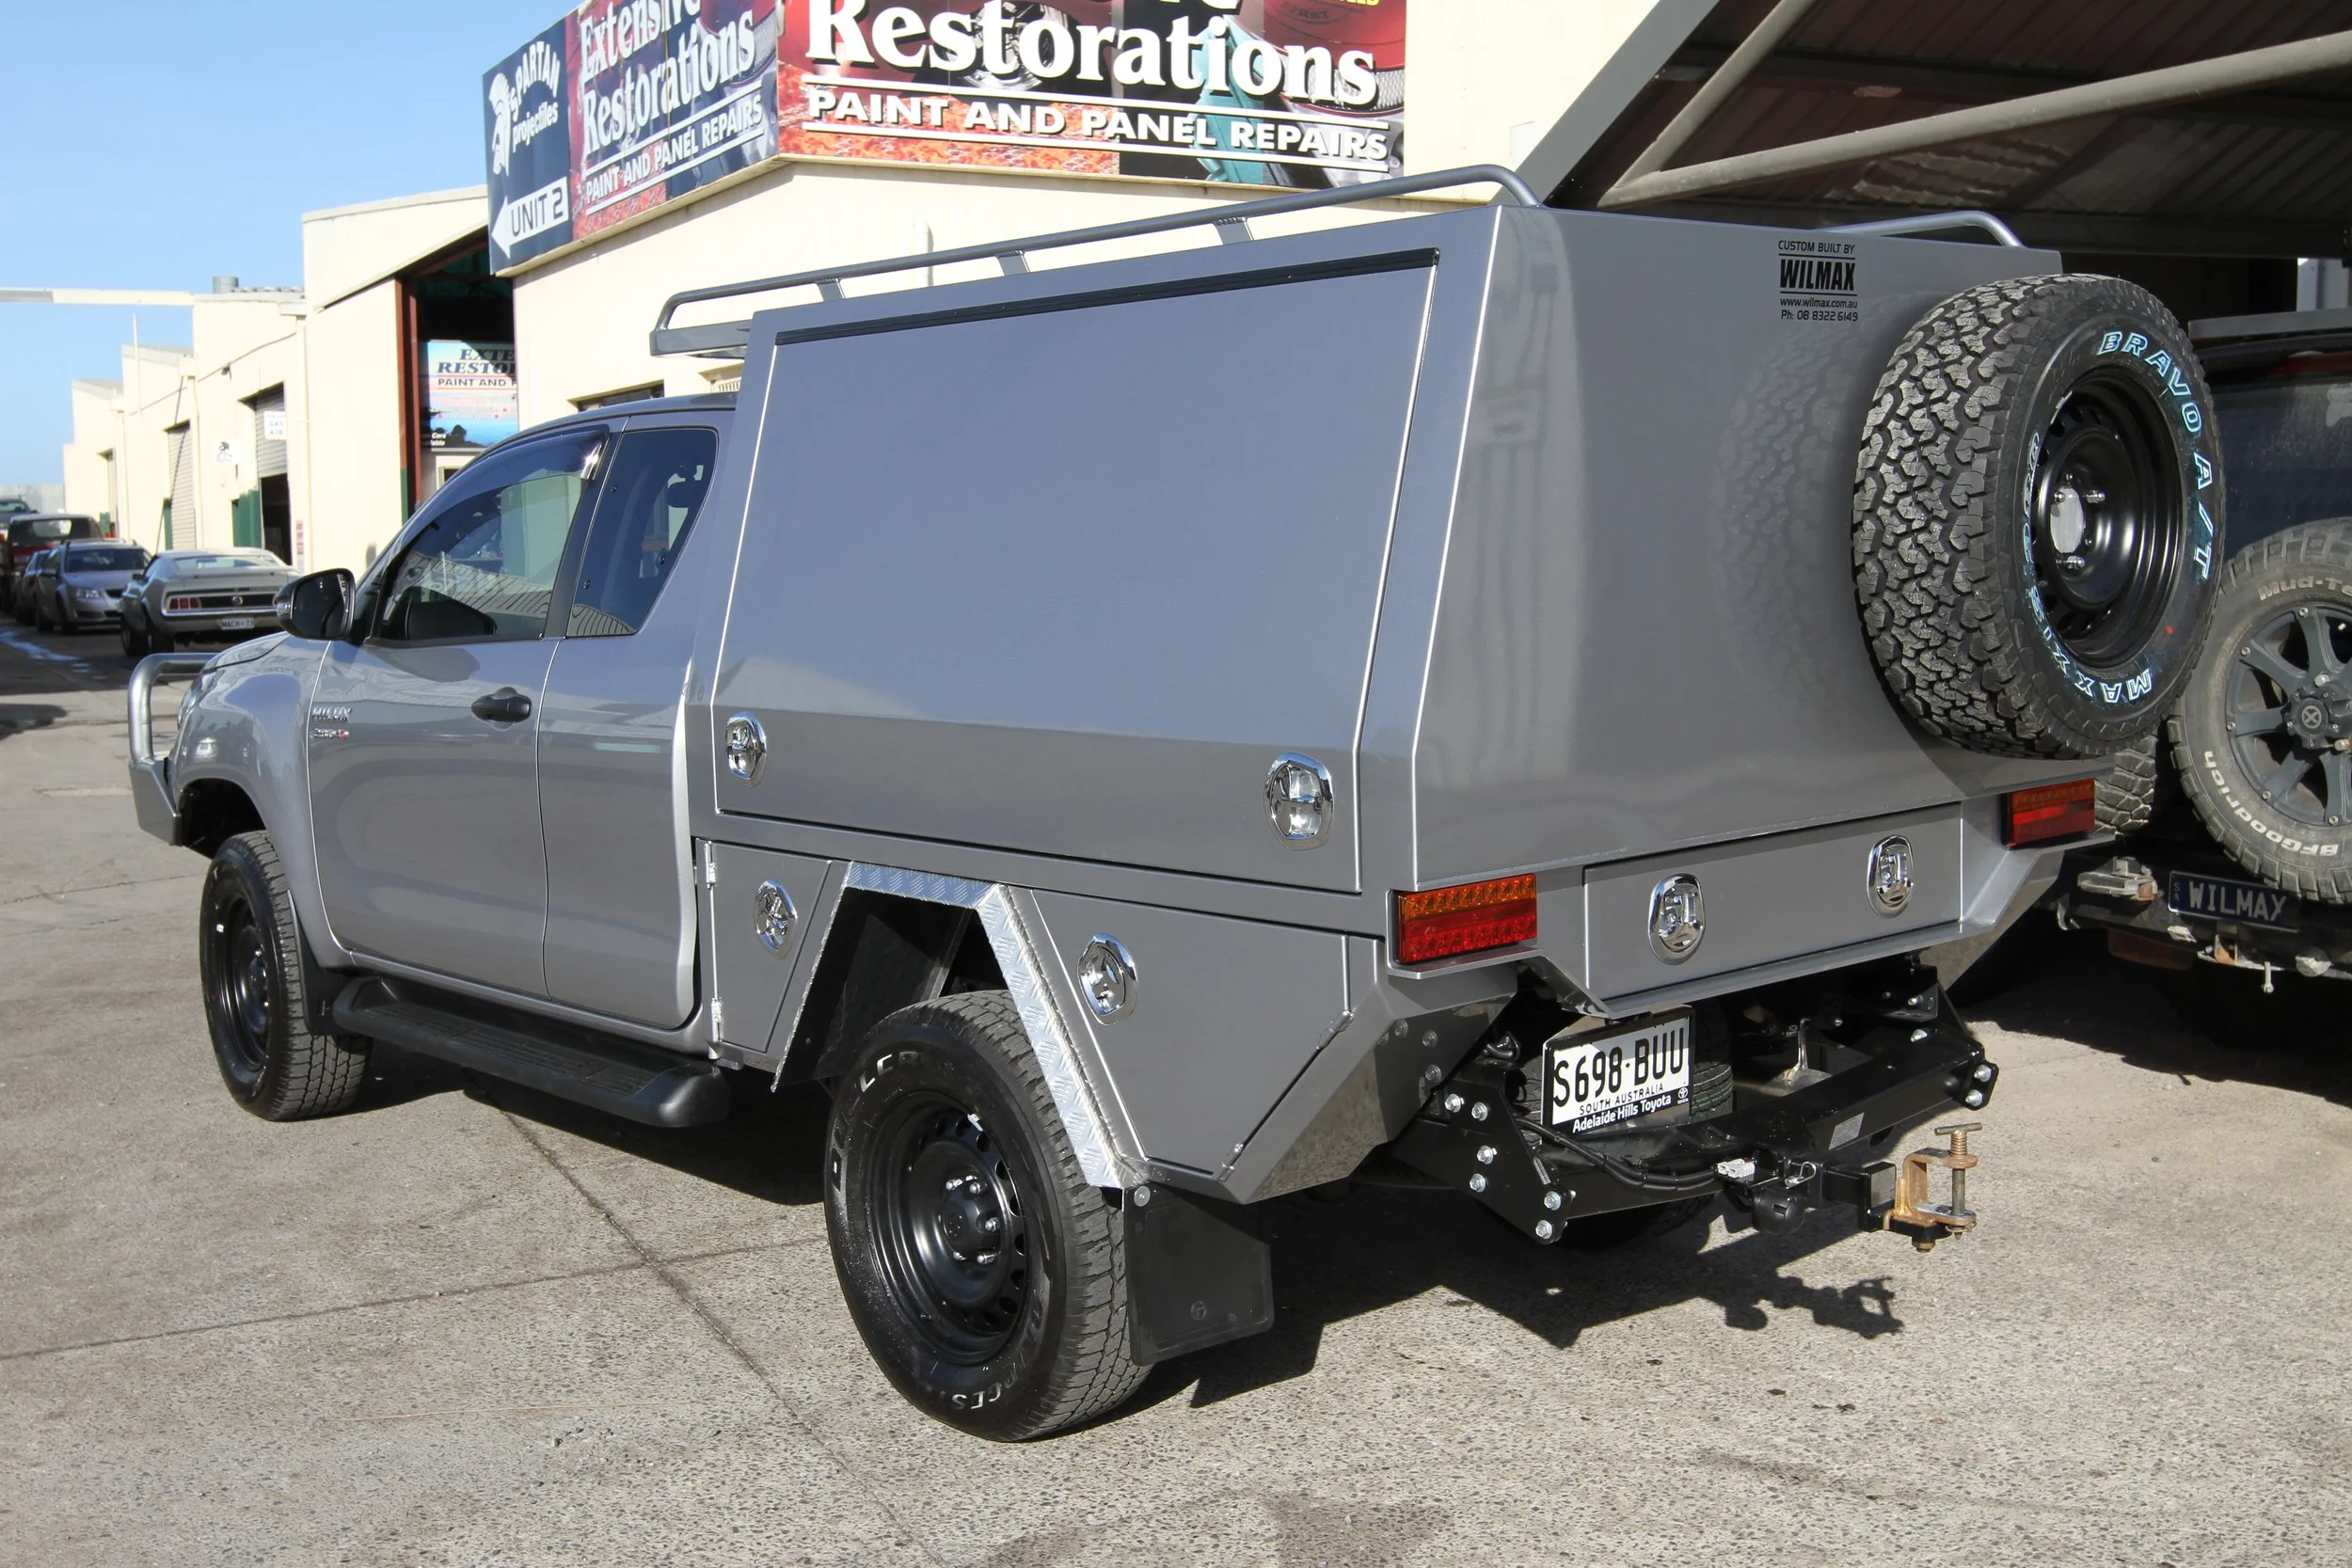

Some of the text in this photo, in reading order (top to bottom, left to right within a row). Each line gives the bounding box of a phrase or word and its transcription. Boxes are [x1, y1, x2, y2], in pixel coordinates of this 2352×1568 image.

[510, 41, 561, 122] SPARTAN
[583, 10, 755, 156] Restorations
[805, 0, 1377, 105] Restorations
[586, 95, 764, 204] PAINT AND PANEL REPAIRS
[809, 89, 1389, 161] PAINT AND PANEL REPAIRS
[511, 187, 564, 237] UNIT 2
[1778, 240, 1855, 254] CUSTOM BUILT BY
[1780, 259, 1855, 291] WILMAX
[1780, 297, 1858, 309] www.wilmax.com.au
[1781, 309, 1858, 322] Ph: 08 8322 6149
[2096, 331, 2214, 579] BRAVO A/T
[2025, 585, 2153, 704] MAXXIS
[2204, 751, 2339, 857] BFGoodrich
[1572, 1093, 1672, 1133] Adelaide Hills Toyota
[1580, 1083, 1664, 1116] SOUTH AUSTRALIA
